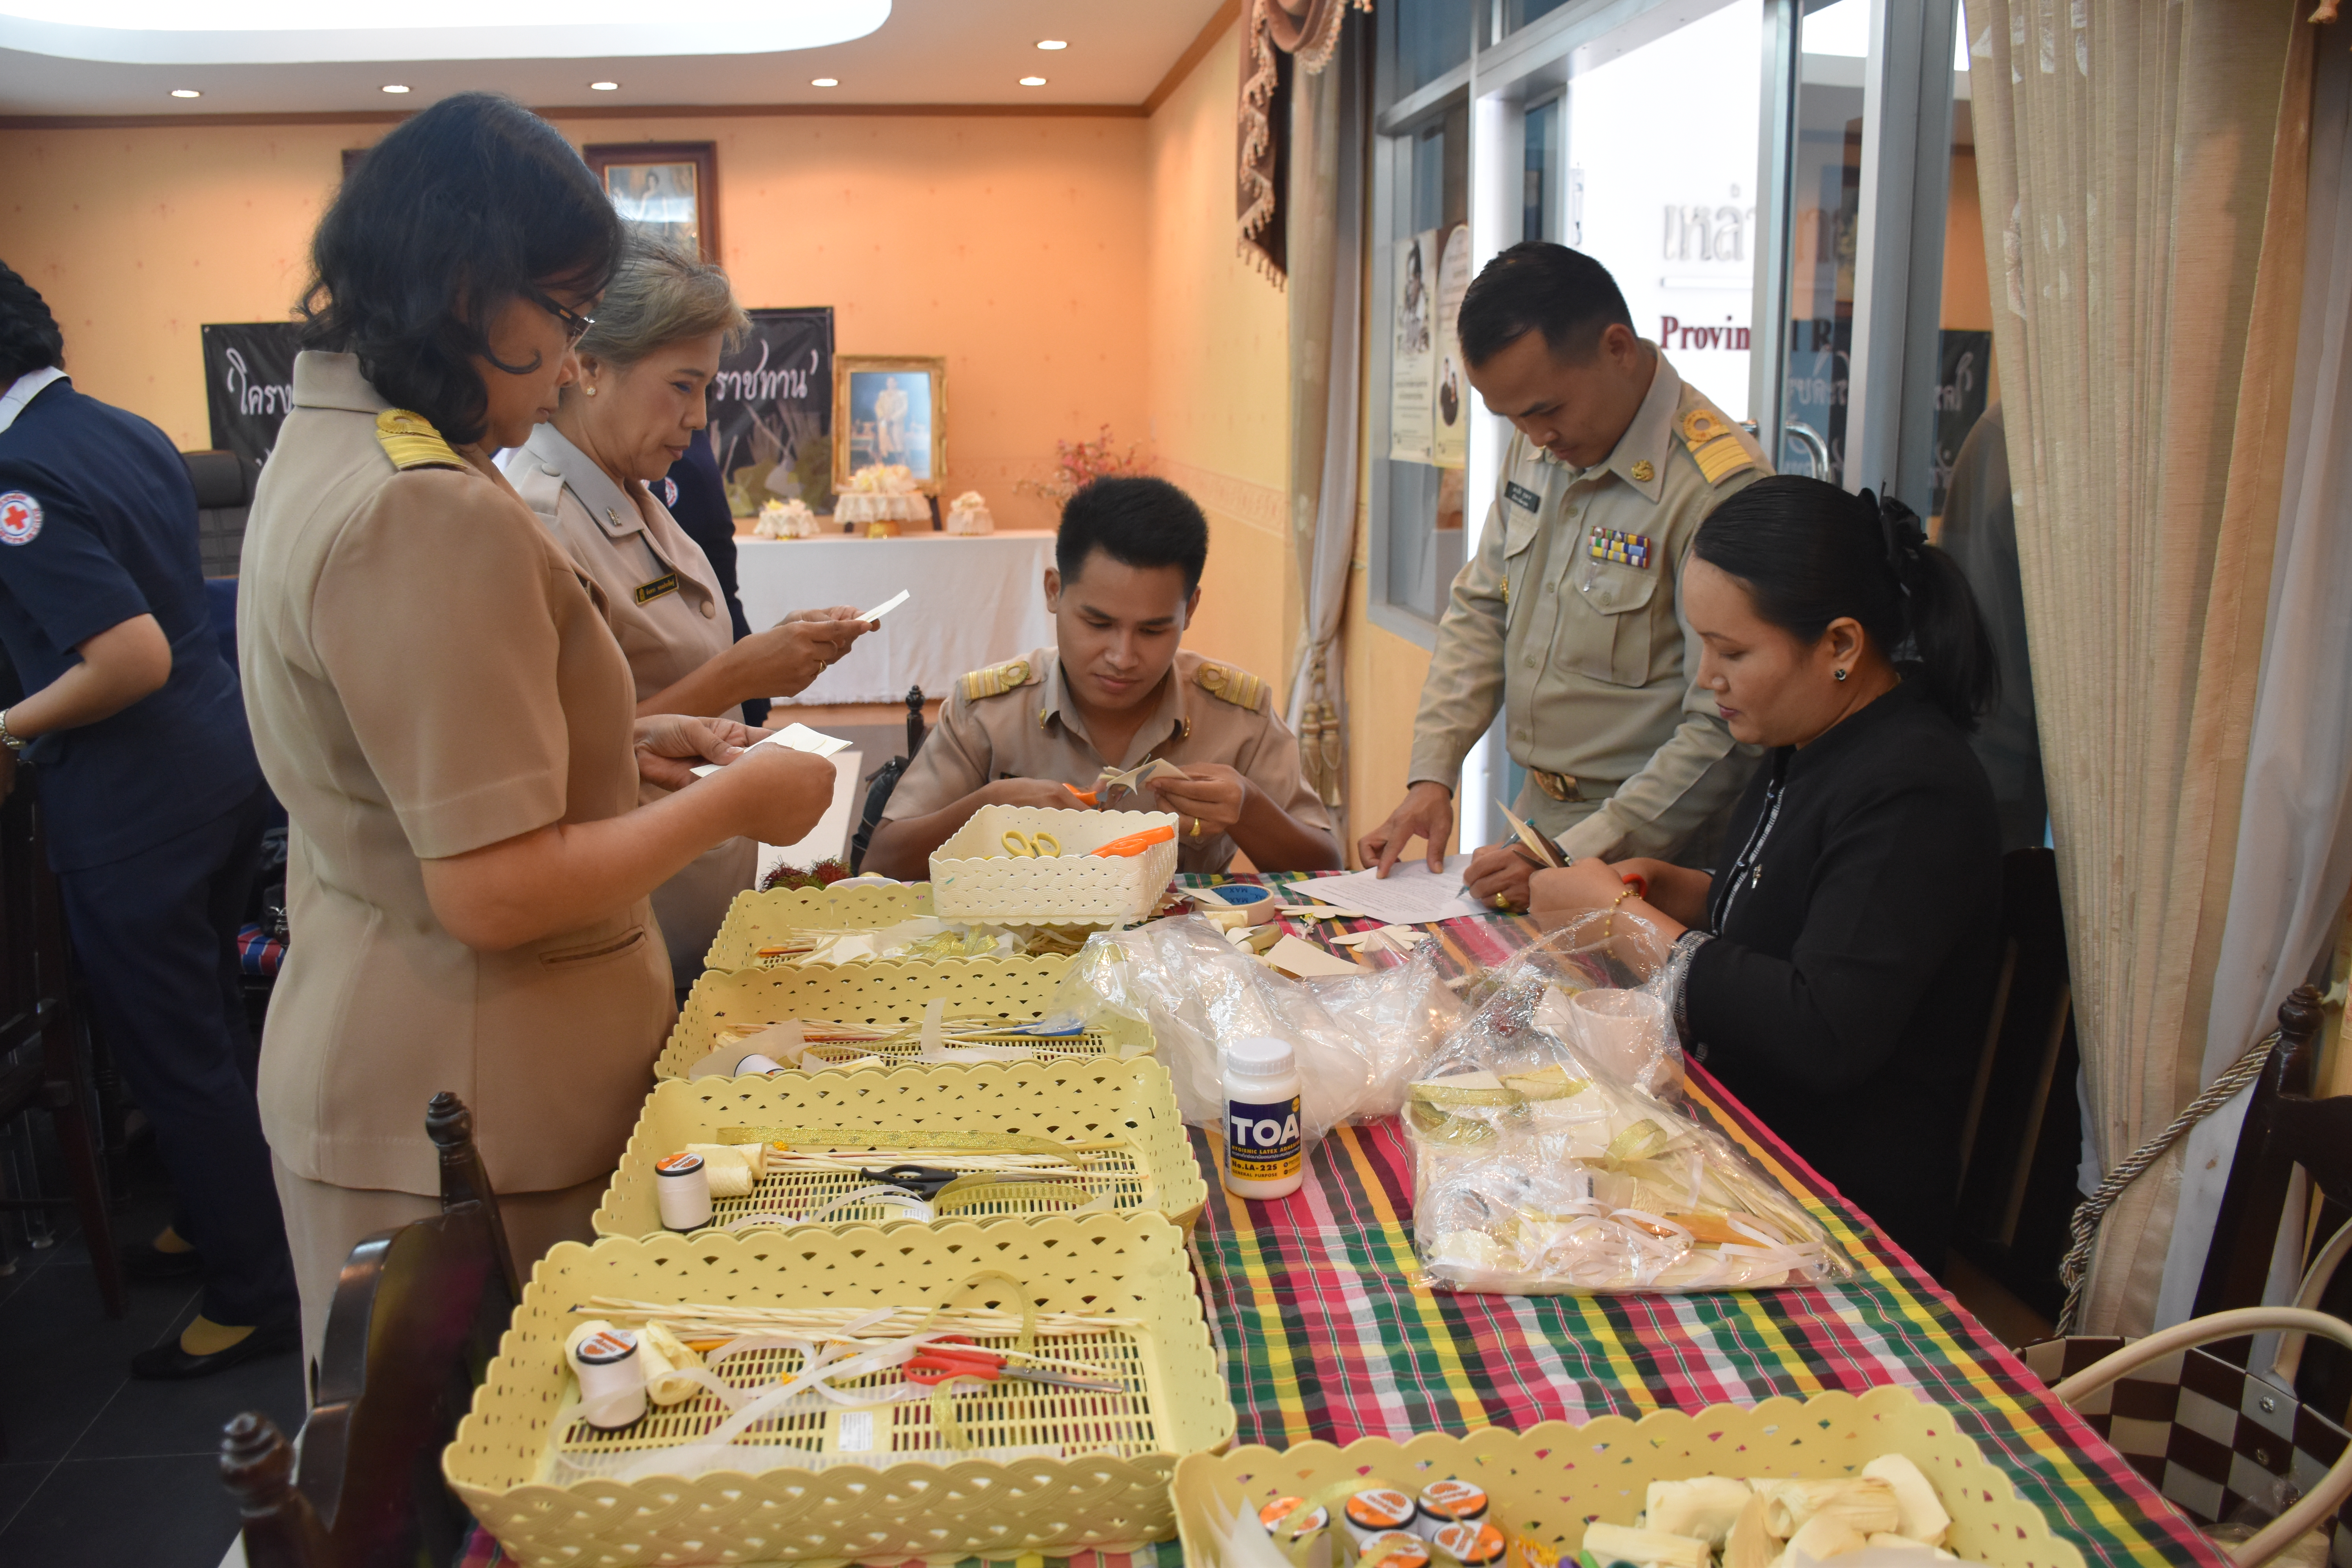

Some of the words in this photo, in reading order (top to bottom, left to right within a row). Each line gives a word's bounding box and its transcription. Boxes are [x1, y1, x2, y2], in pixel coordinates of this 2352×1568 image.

[1231, 1113, 1299, 1147] TOA
[1232, 1145, 1257, 1154] HYGIENIC
[1280, 1140, 1300, 1153] ADHESIVE
